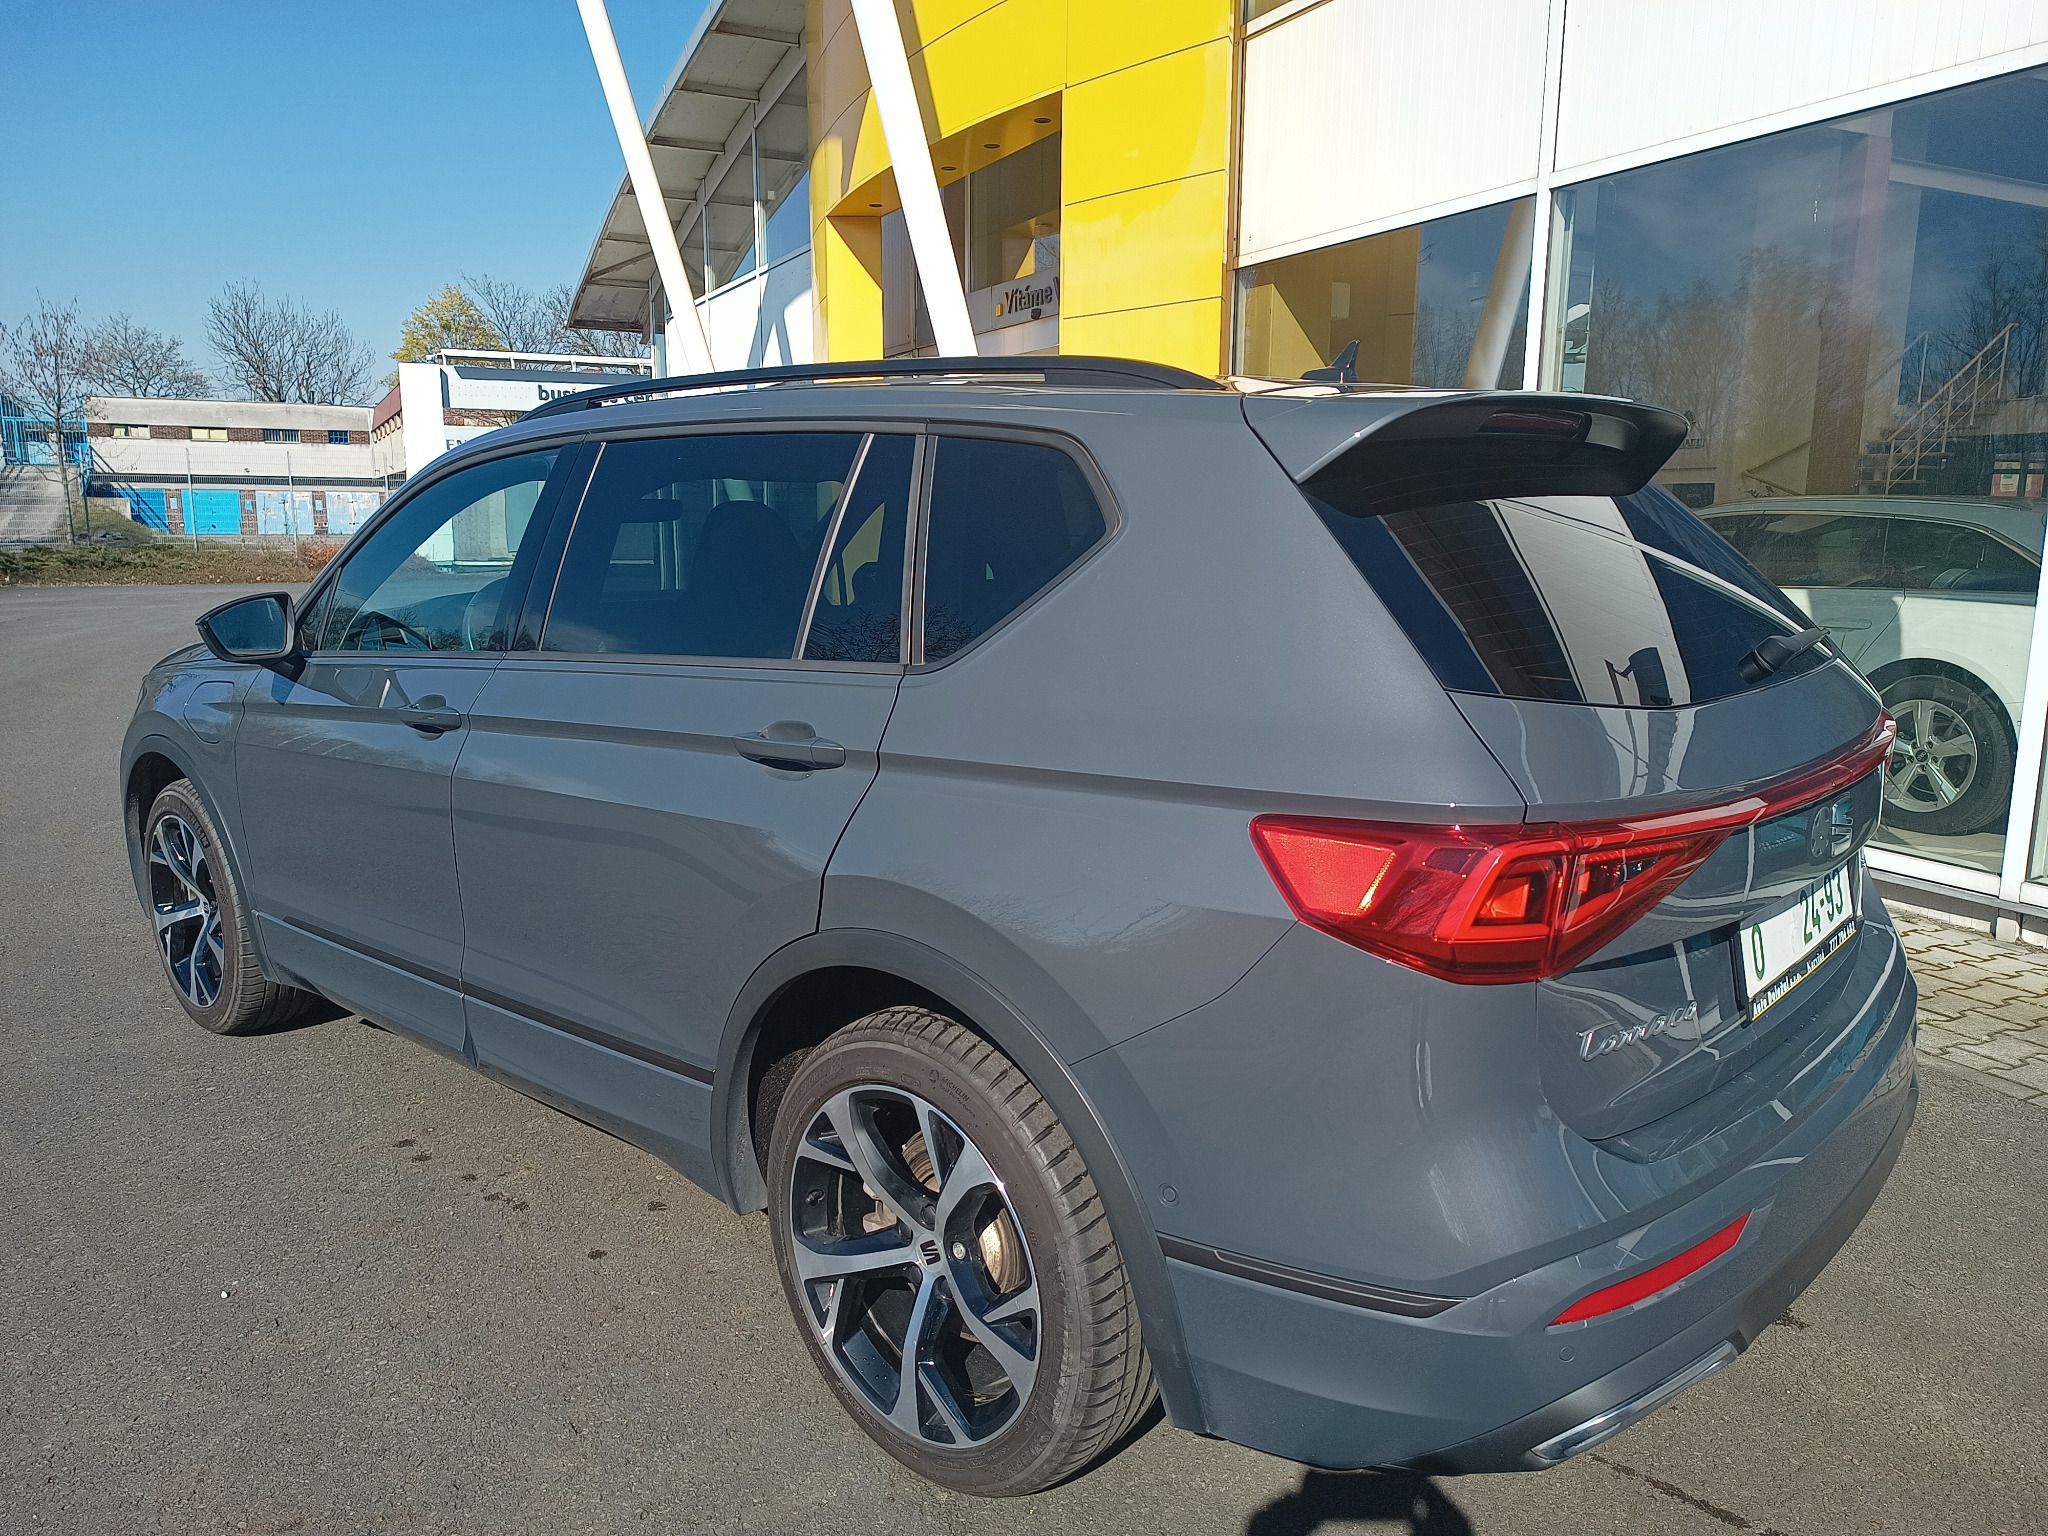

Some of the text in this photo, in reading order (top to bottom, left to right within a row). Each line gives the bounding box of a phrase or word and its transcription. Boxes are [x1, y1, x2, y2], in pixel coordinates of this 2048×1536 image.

[1004, 285, 1053, 314] Vítáme
[1800, 867, 1844, 946] 24-93
[1576, 1001, 1698, 1062] Tarraco
[941, 1076, 970, 1102] MICHELIN
